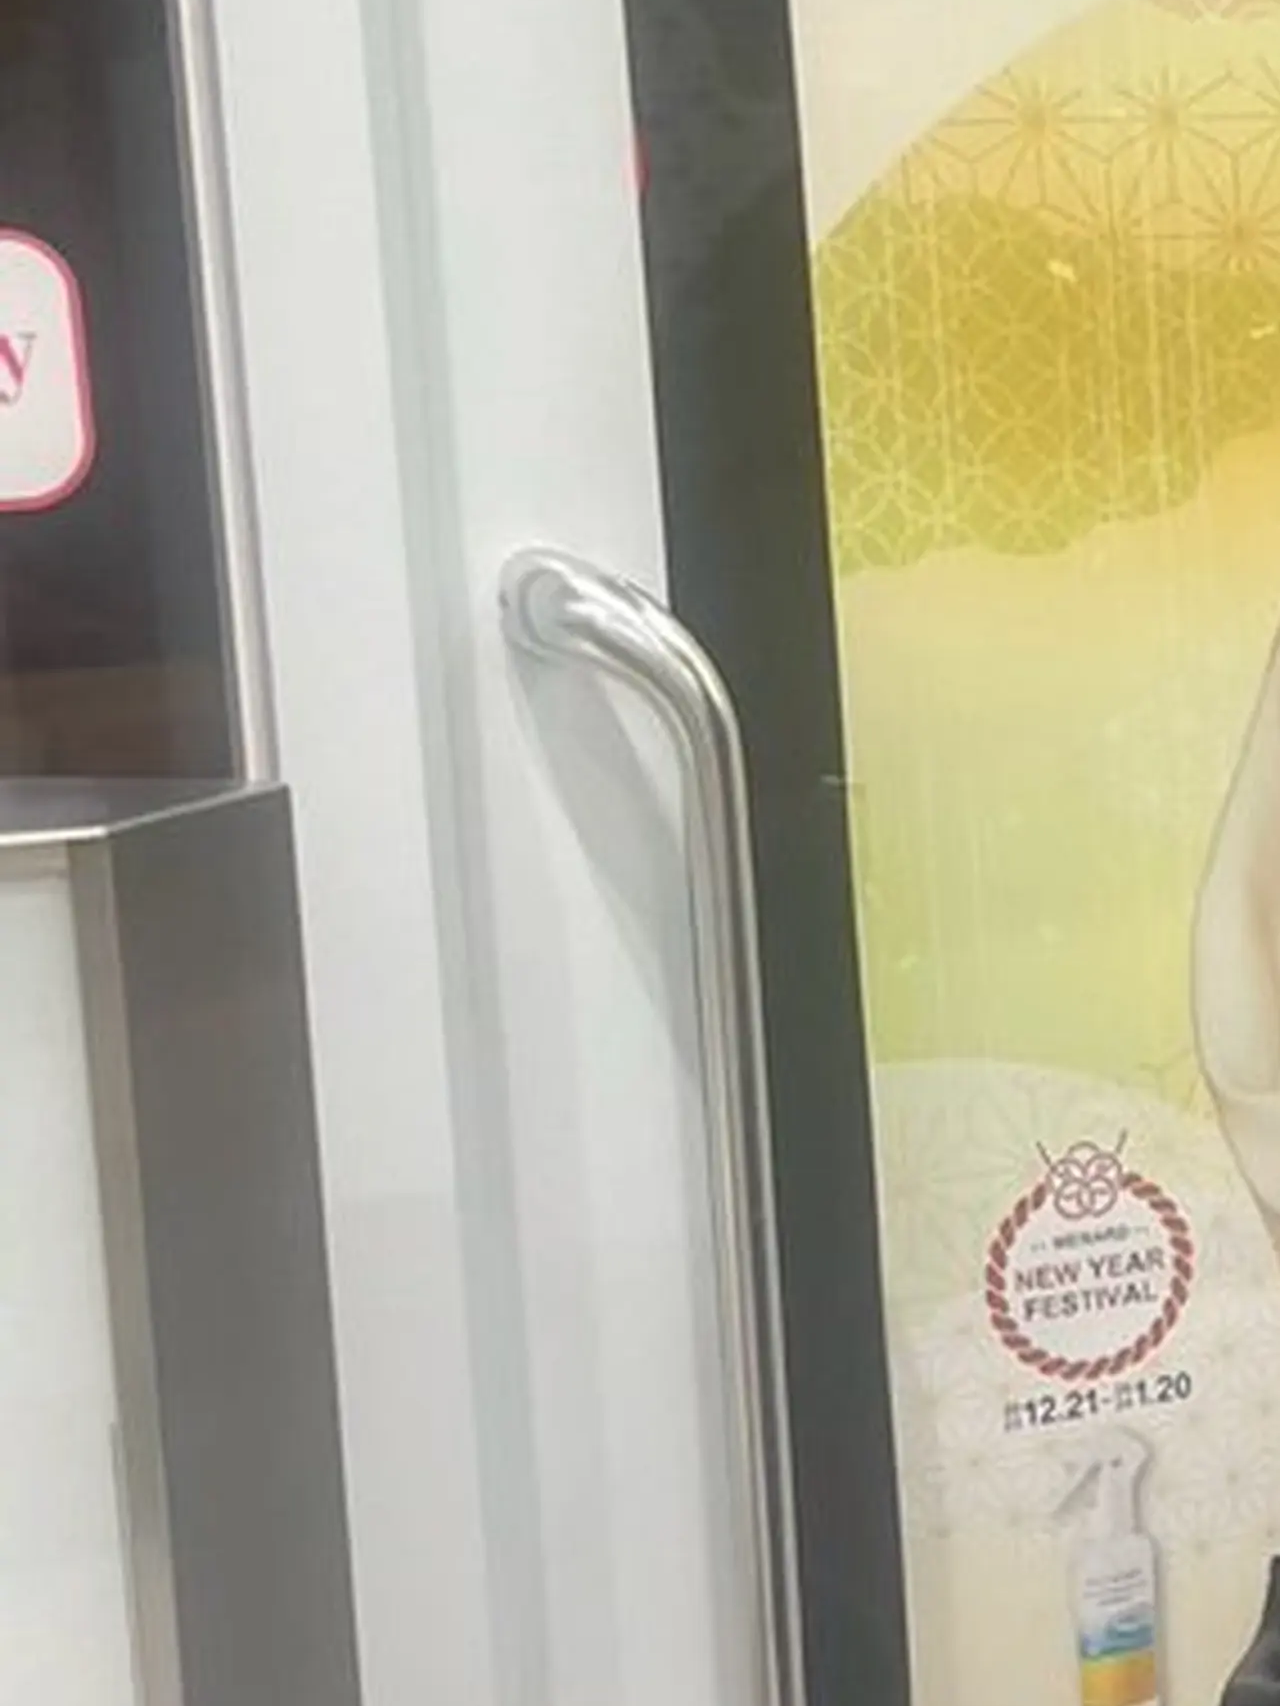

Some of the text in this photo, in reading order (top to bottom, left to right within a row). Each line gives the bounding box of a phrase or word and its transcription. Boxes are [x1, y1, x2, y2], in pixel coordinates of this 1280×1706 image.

[1014, 1246, 1166, 1292] NEW YEAR
[1023, 1279, 1159, 1322] FESTIVAL
